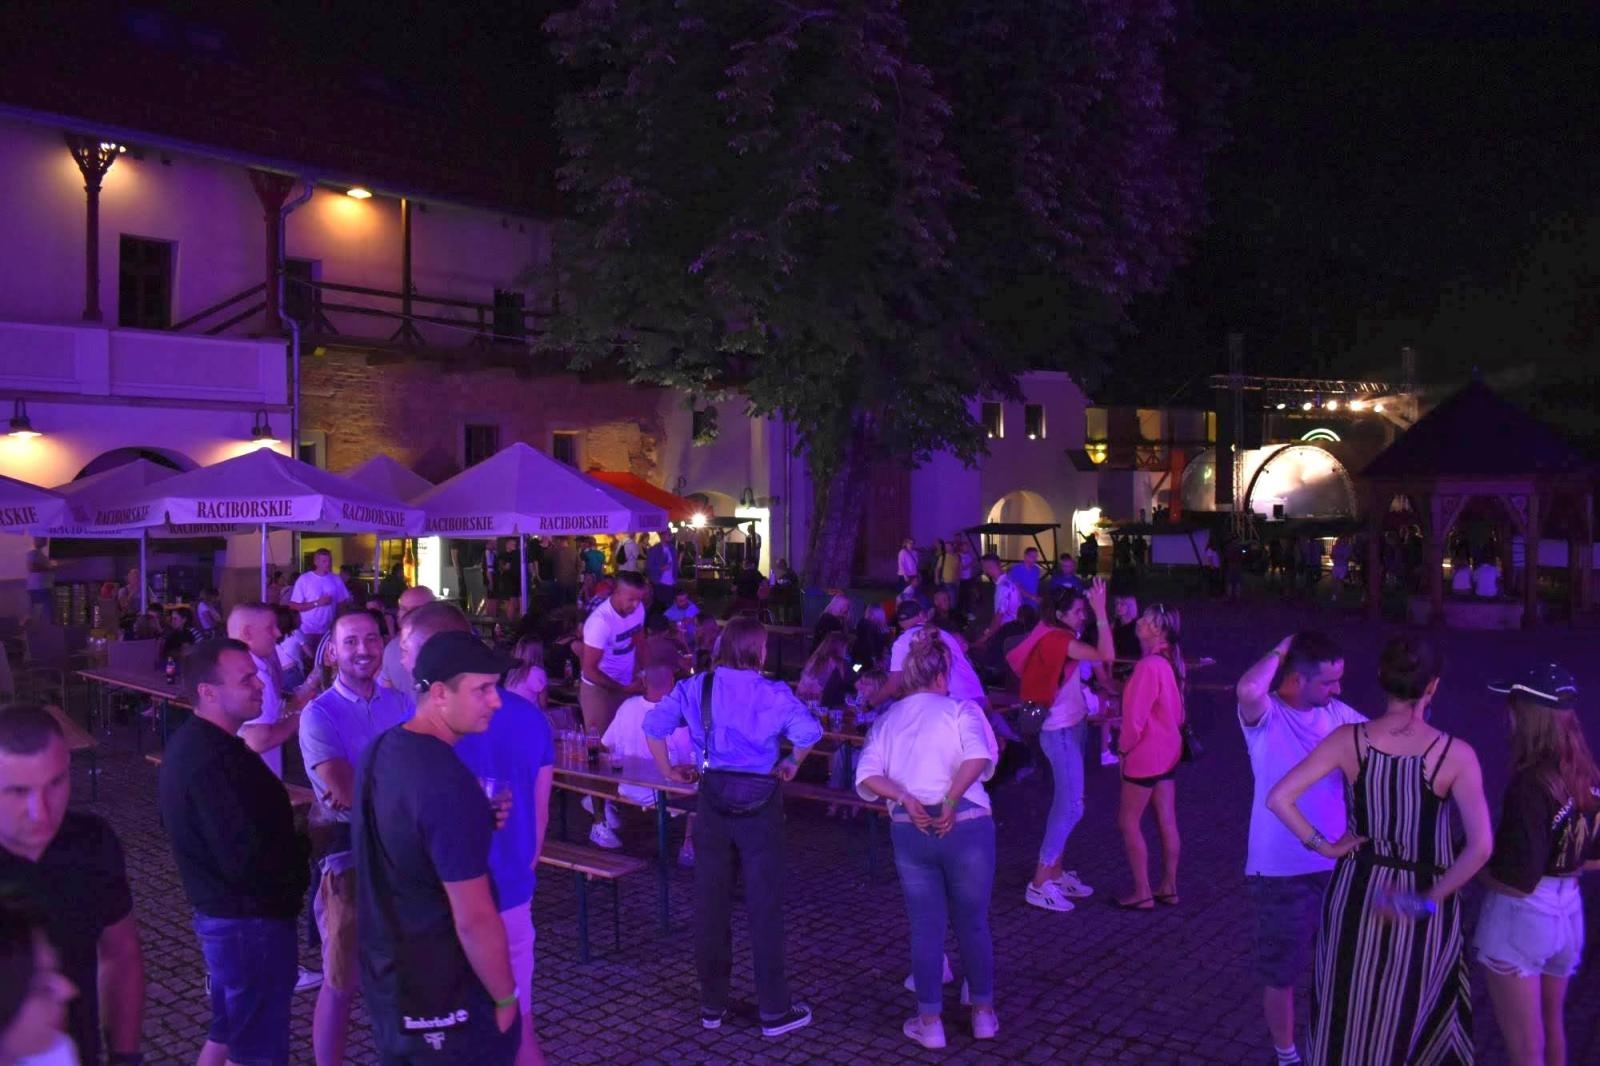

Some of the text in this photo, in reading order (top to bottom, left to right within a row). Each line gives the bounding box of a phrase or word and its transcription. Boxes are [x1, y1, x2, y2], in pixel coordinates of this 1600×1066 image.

[197, 499, 292, 518] RACIBORSKIE
[342, 503, 406, 527] RACIBORSKIE
[425, 516, 494, 531] RACIBORSKIE
[539, 515, 609, 530] RACIBORSKIE
